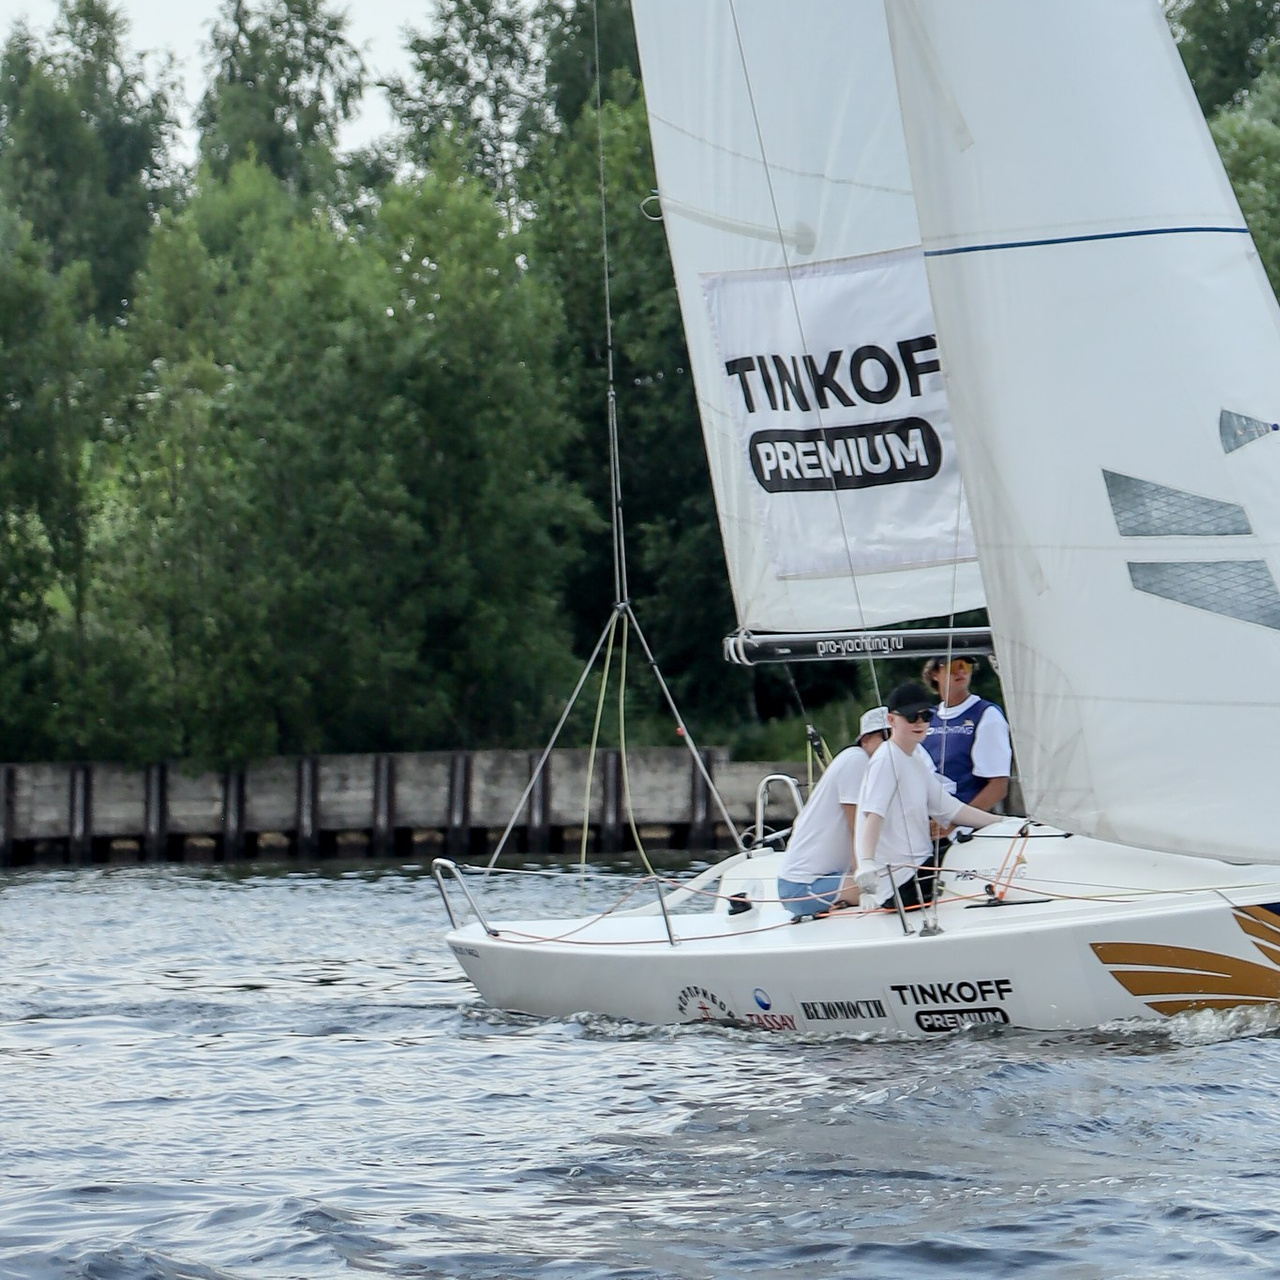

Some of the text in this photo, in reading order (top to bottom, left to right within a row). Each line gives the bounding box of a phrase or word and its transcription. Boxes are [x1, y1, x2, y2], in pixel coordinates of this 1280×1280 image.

[725, 334, 941, 413] TINKOF
[756, 428, 930, 482] PREMIUM
[890, 979, 1013, 1006] TINKOFF
[745, 1013, 798, 1031] TASSAY
[919, 1011, 1004, 1028] PREMIUM
